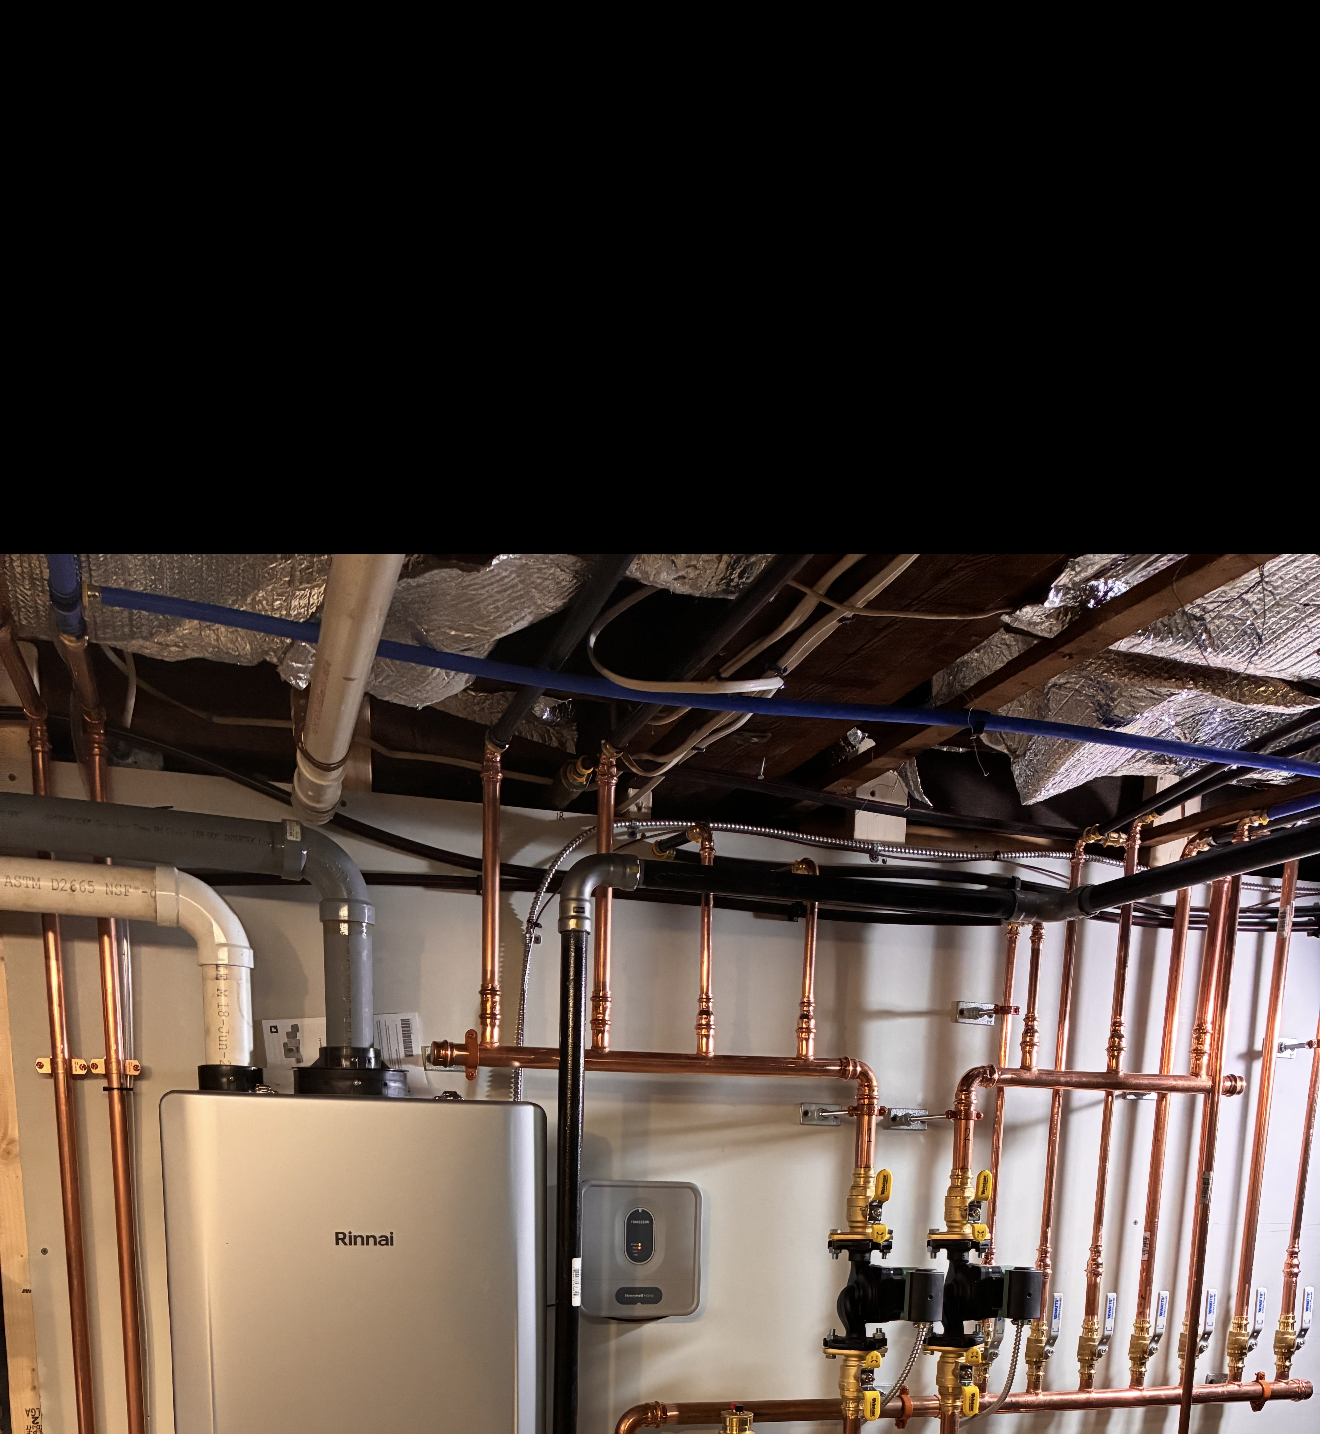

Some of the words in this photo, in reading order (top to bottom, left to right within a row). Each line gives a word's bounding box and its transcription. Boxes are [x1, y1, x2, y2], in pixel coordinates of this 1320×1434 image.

[4, 874, 41, 890] ASTM
[51, 878, 95, 894] D2665
[105, 882, 132, 897] NSF
[334, 1230, 394, 1246] Rinnai
[32, 1416, 40, 1424] 2
